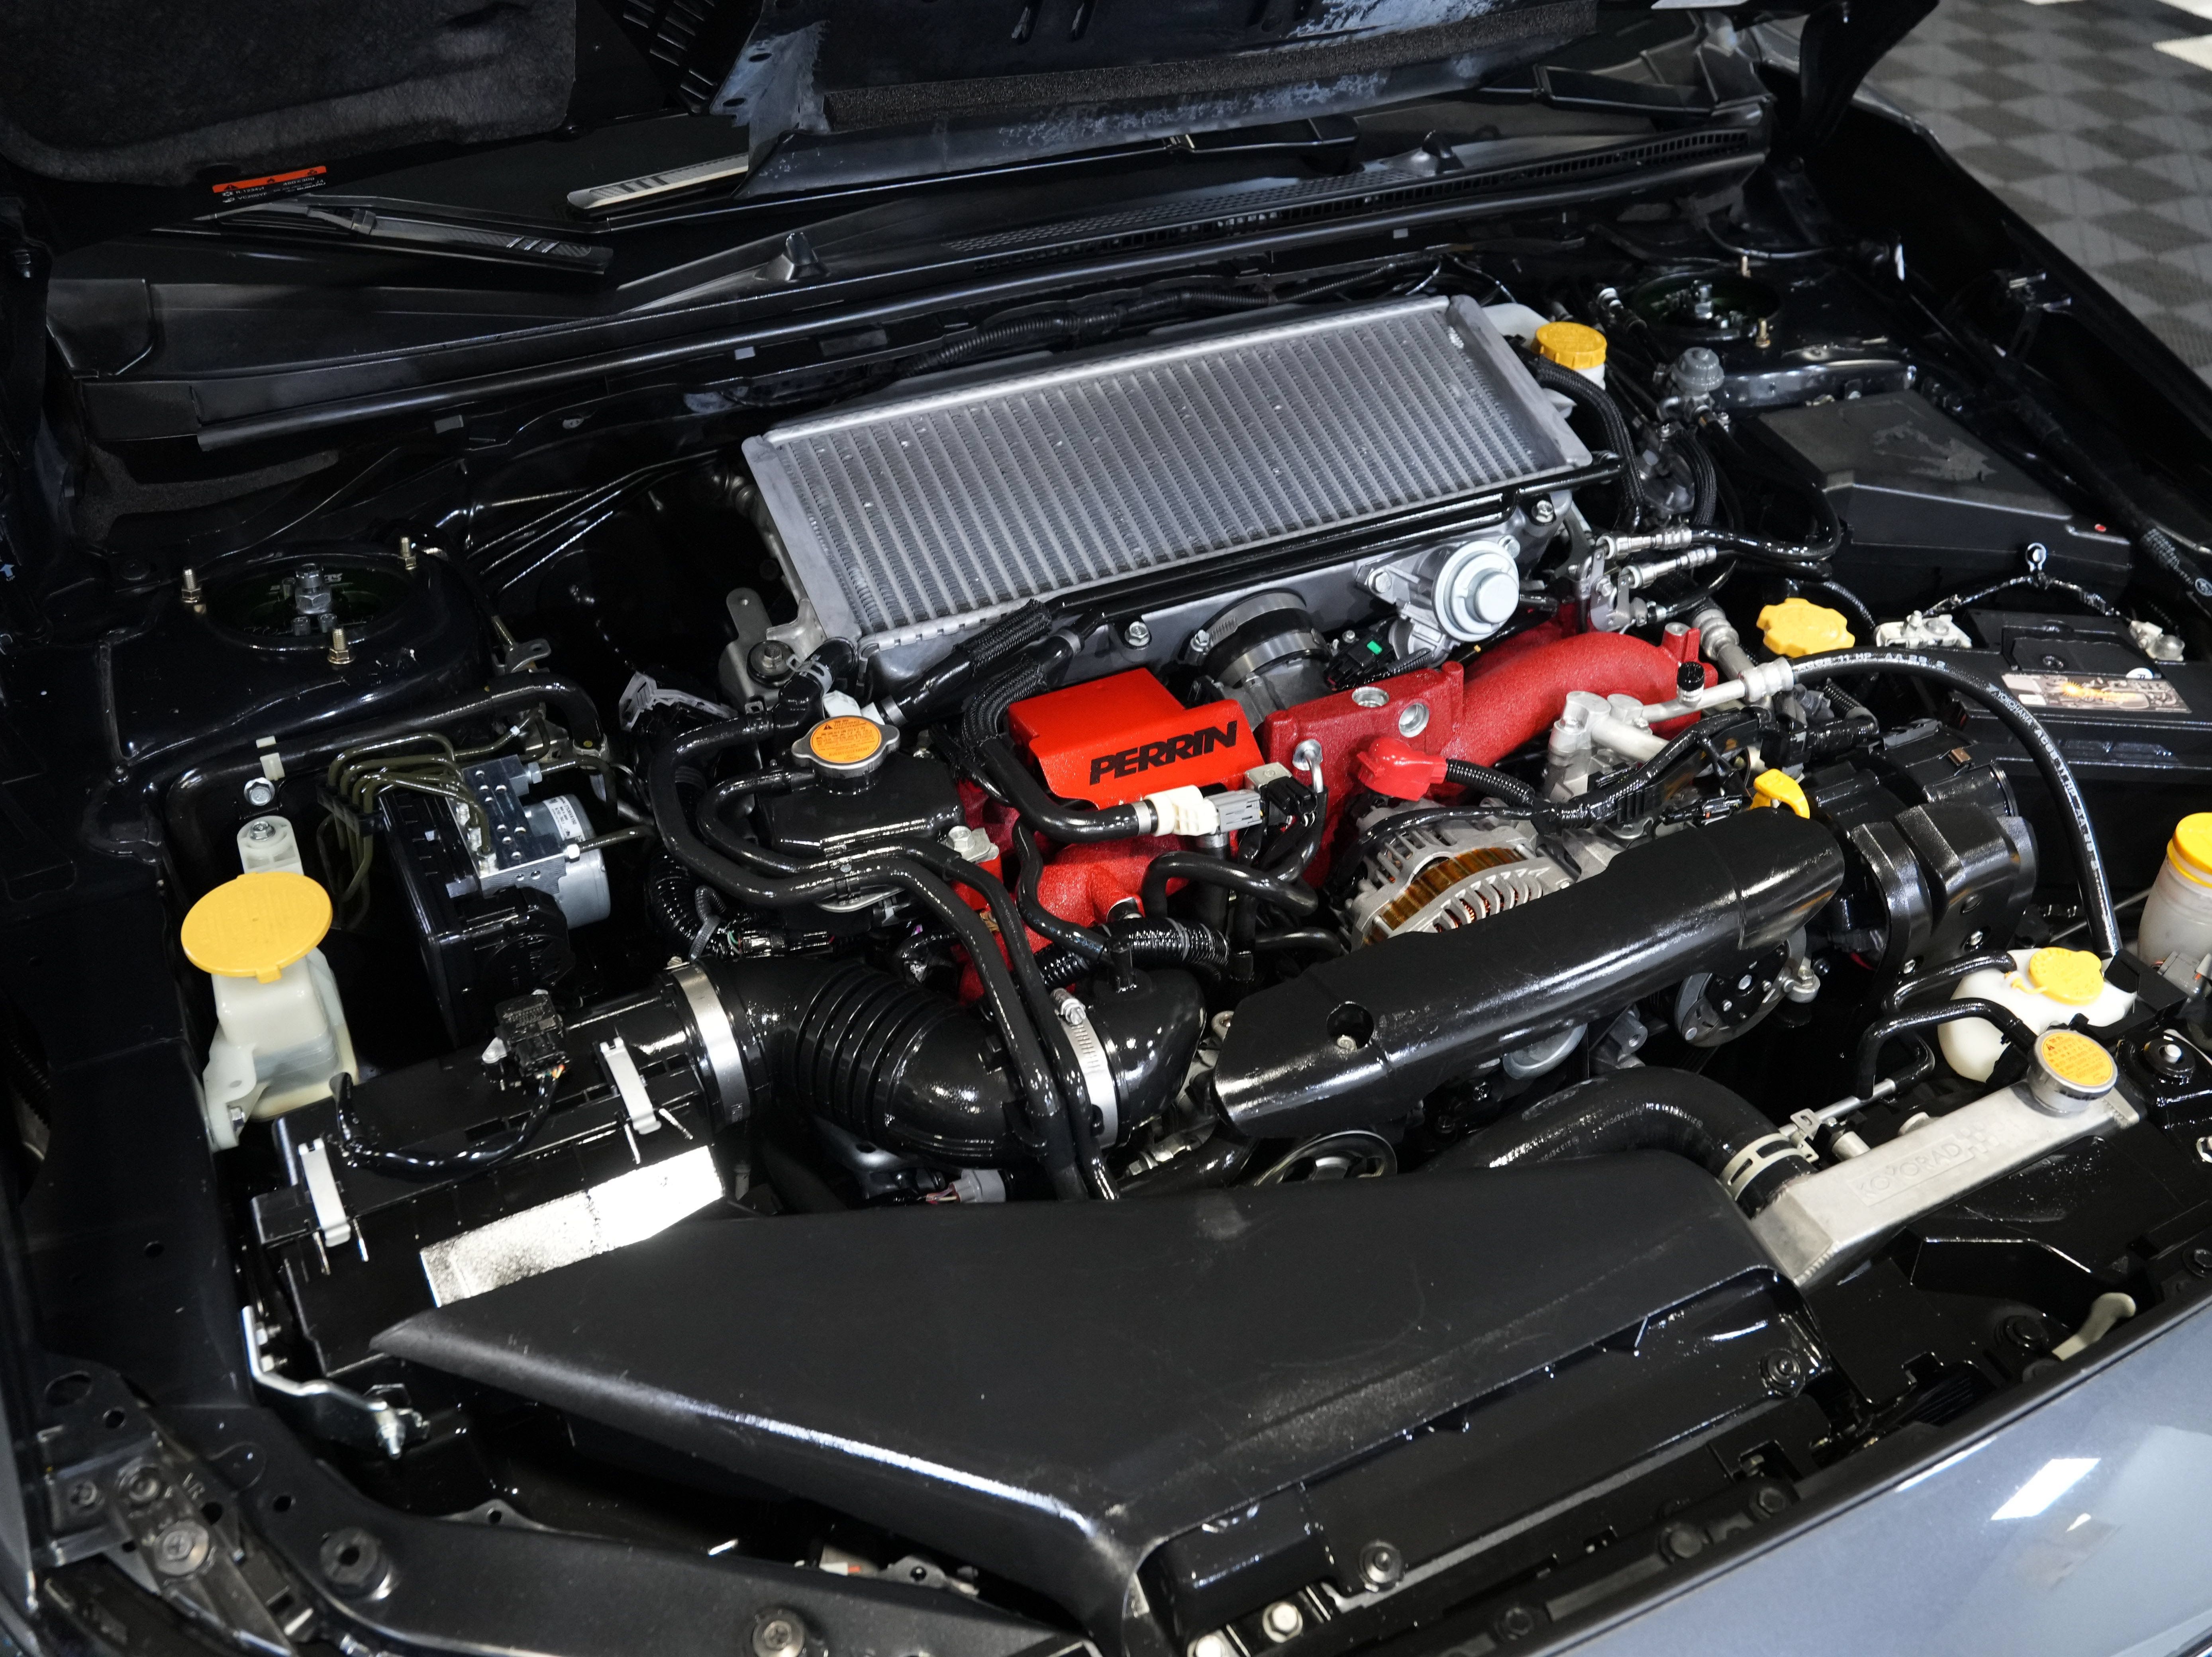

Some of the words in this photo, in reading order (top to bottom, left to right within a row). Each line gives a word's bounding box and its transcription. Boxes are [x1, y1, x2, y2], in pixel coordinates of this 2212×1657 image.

[1997, 690, 2033, 726] YOKOHAMA
[1090, 720, 1237, 785] PERRIN
[1858, 1142, 1962, 1198] KOYORAD
